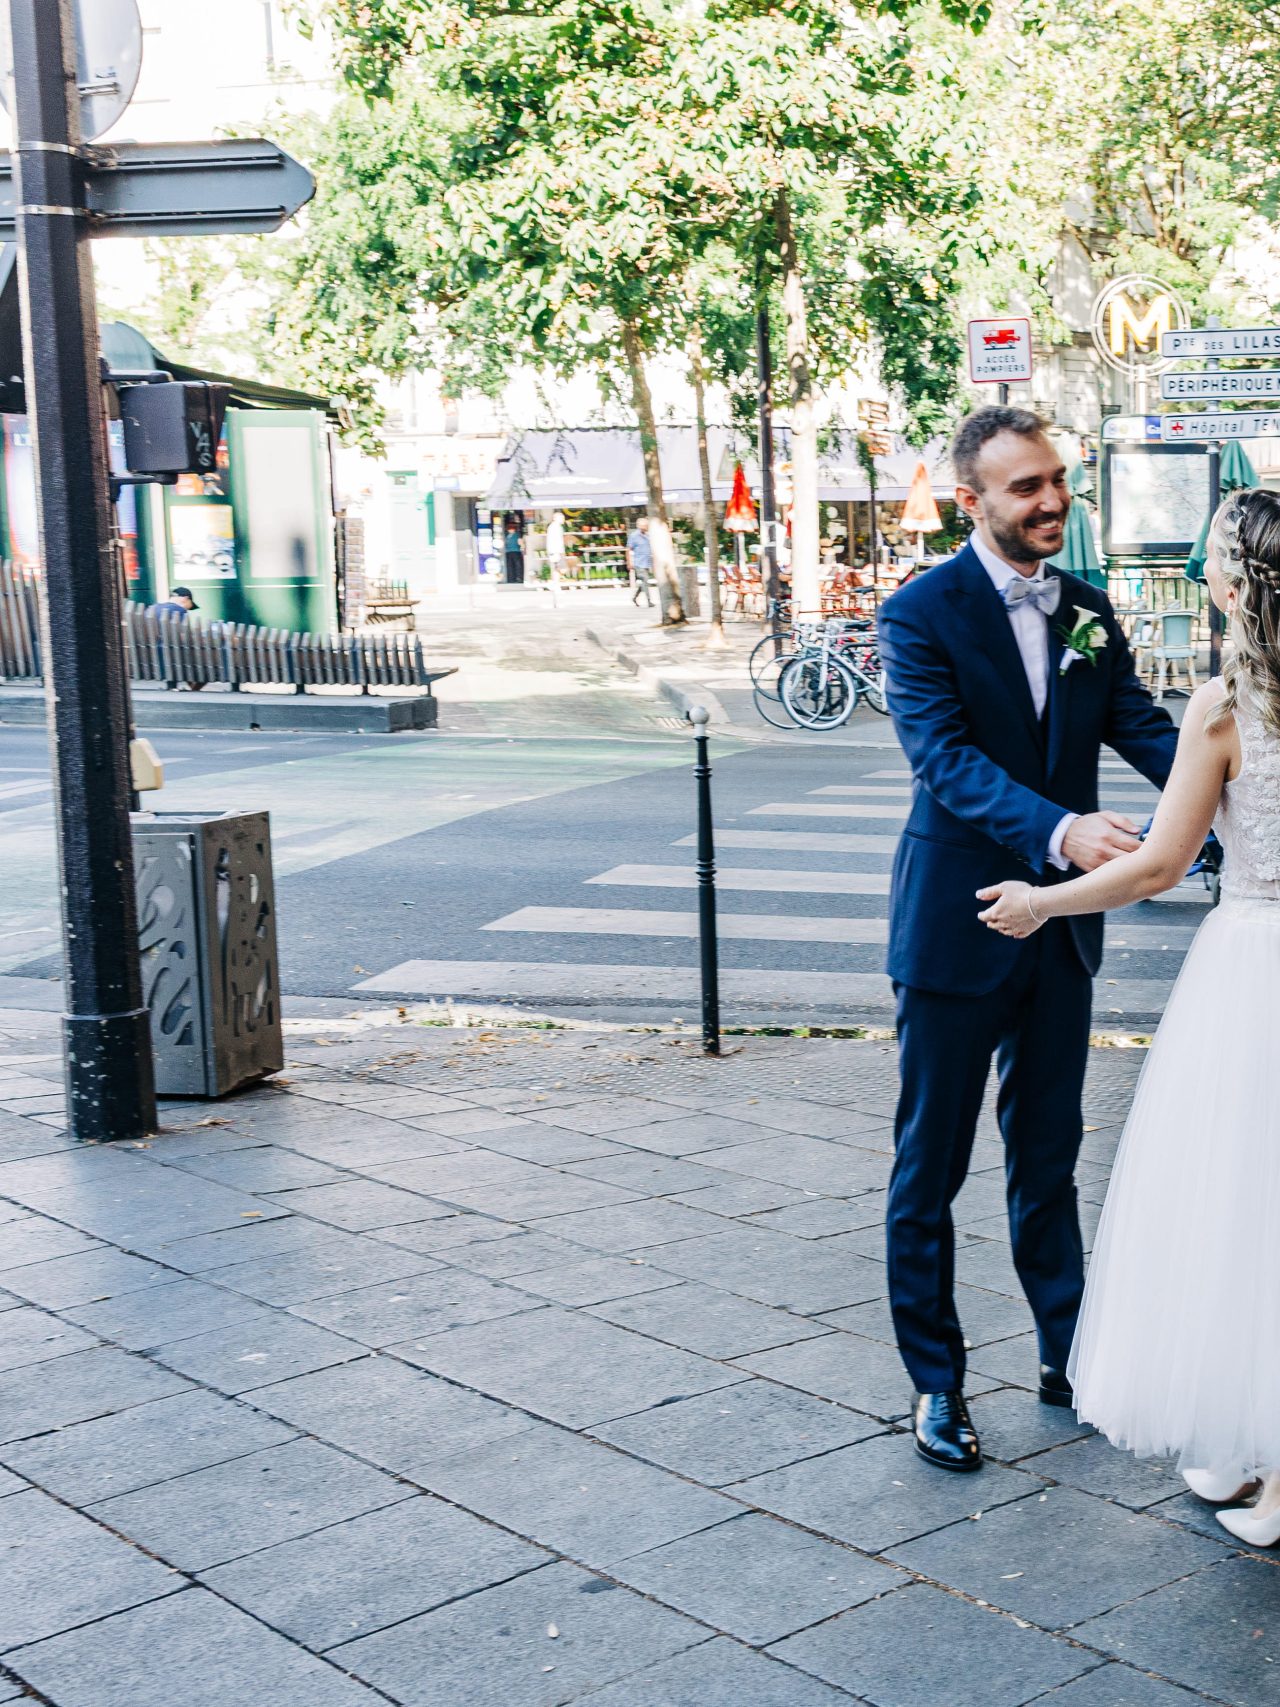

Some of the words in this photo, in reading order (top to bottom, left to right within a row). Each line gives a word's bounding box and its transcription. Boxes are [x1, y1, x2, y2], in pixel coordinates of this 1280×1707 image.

[1109, 294, 1171, 357] M
[977, 364, 1026, 373] POMPIERS
[1168, 376, 1272, 393] PÉRIPHÉRIQUE
[1190, 418, 1244, 435] Hôpital
